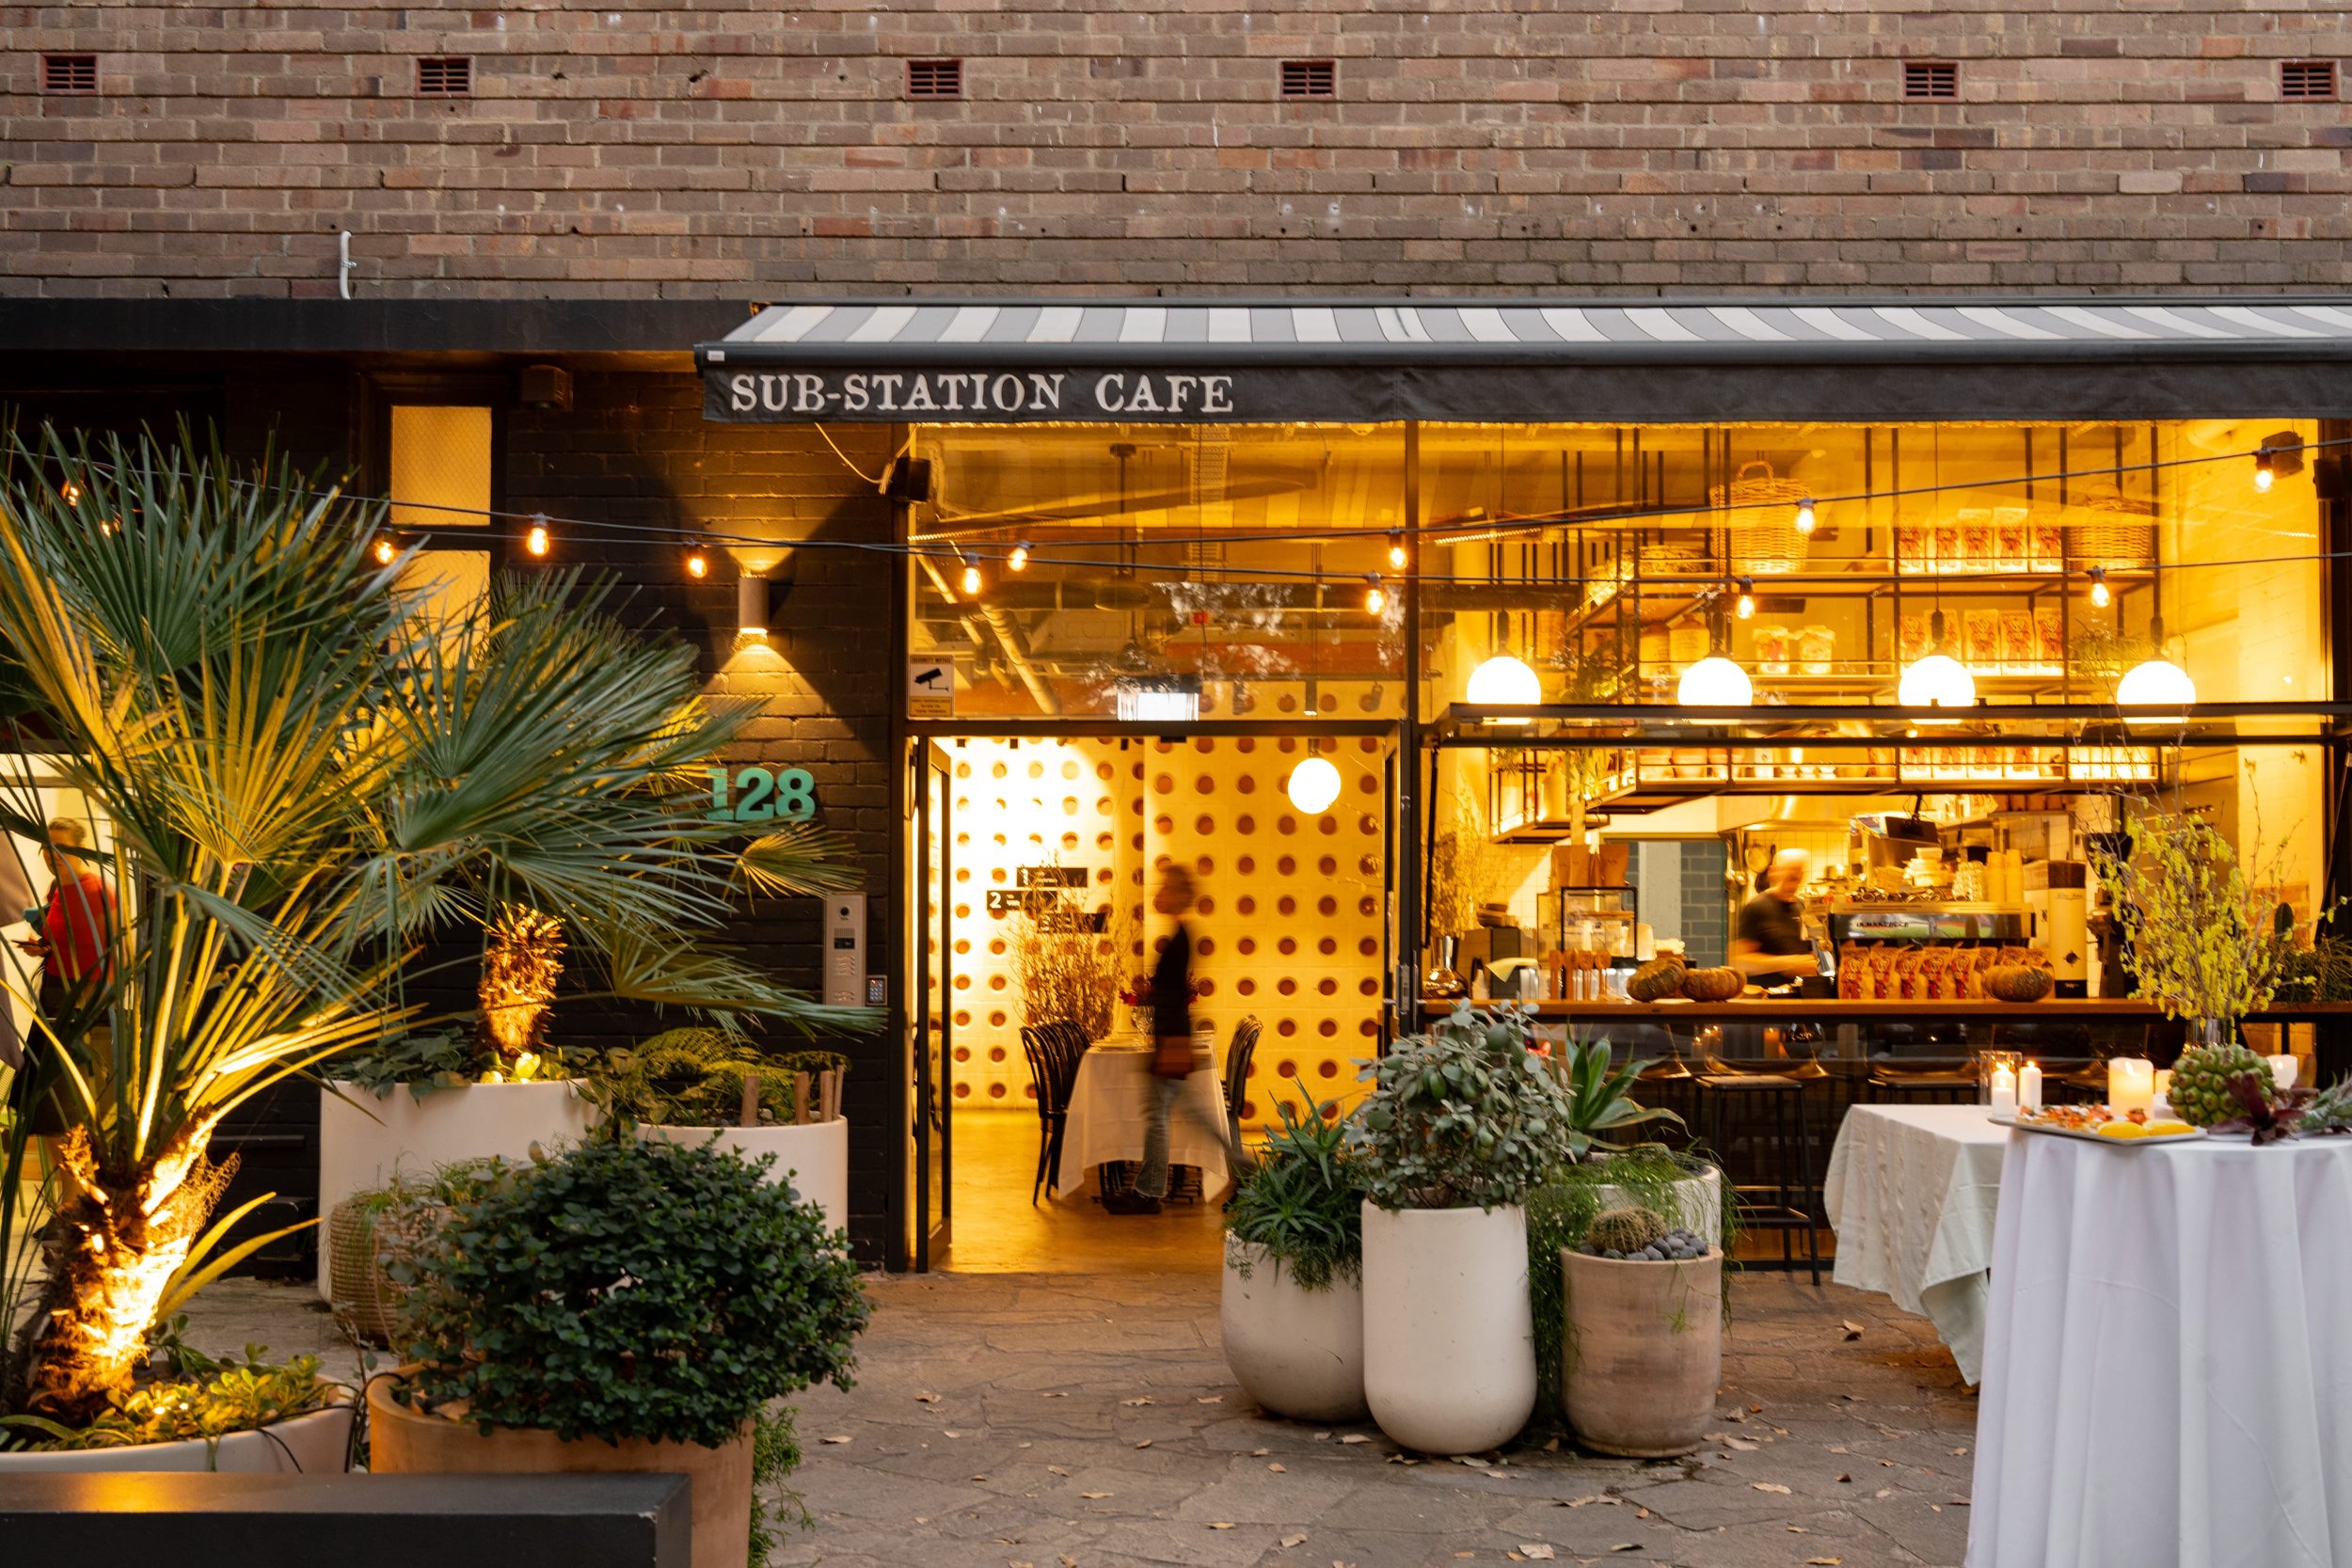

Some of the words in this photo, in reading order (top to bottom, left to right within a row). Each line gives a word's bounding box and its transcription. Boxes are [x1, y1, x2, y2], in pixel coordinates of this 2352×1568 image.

[731, 373, 1065, 411] SUB-STATION
[1094, 373, 1233, 412] CAFE
[707, 767, 816, 822] 128
[989, 892, 1002, 909] 2
